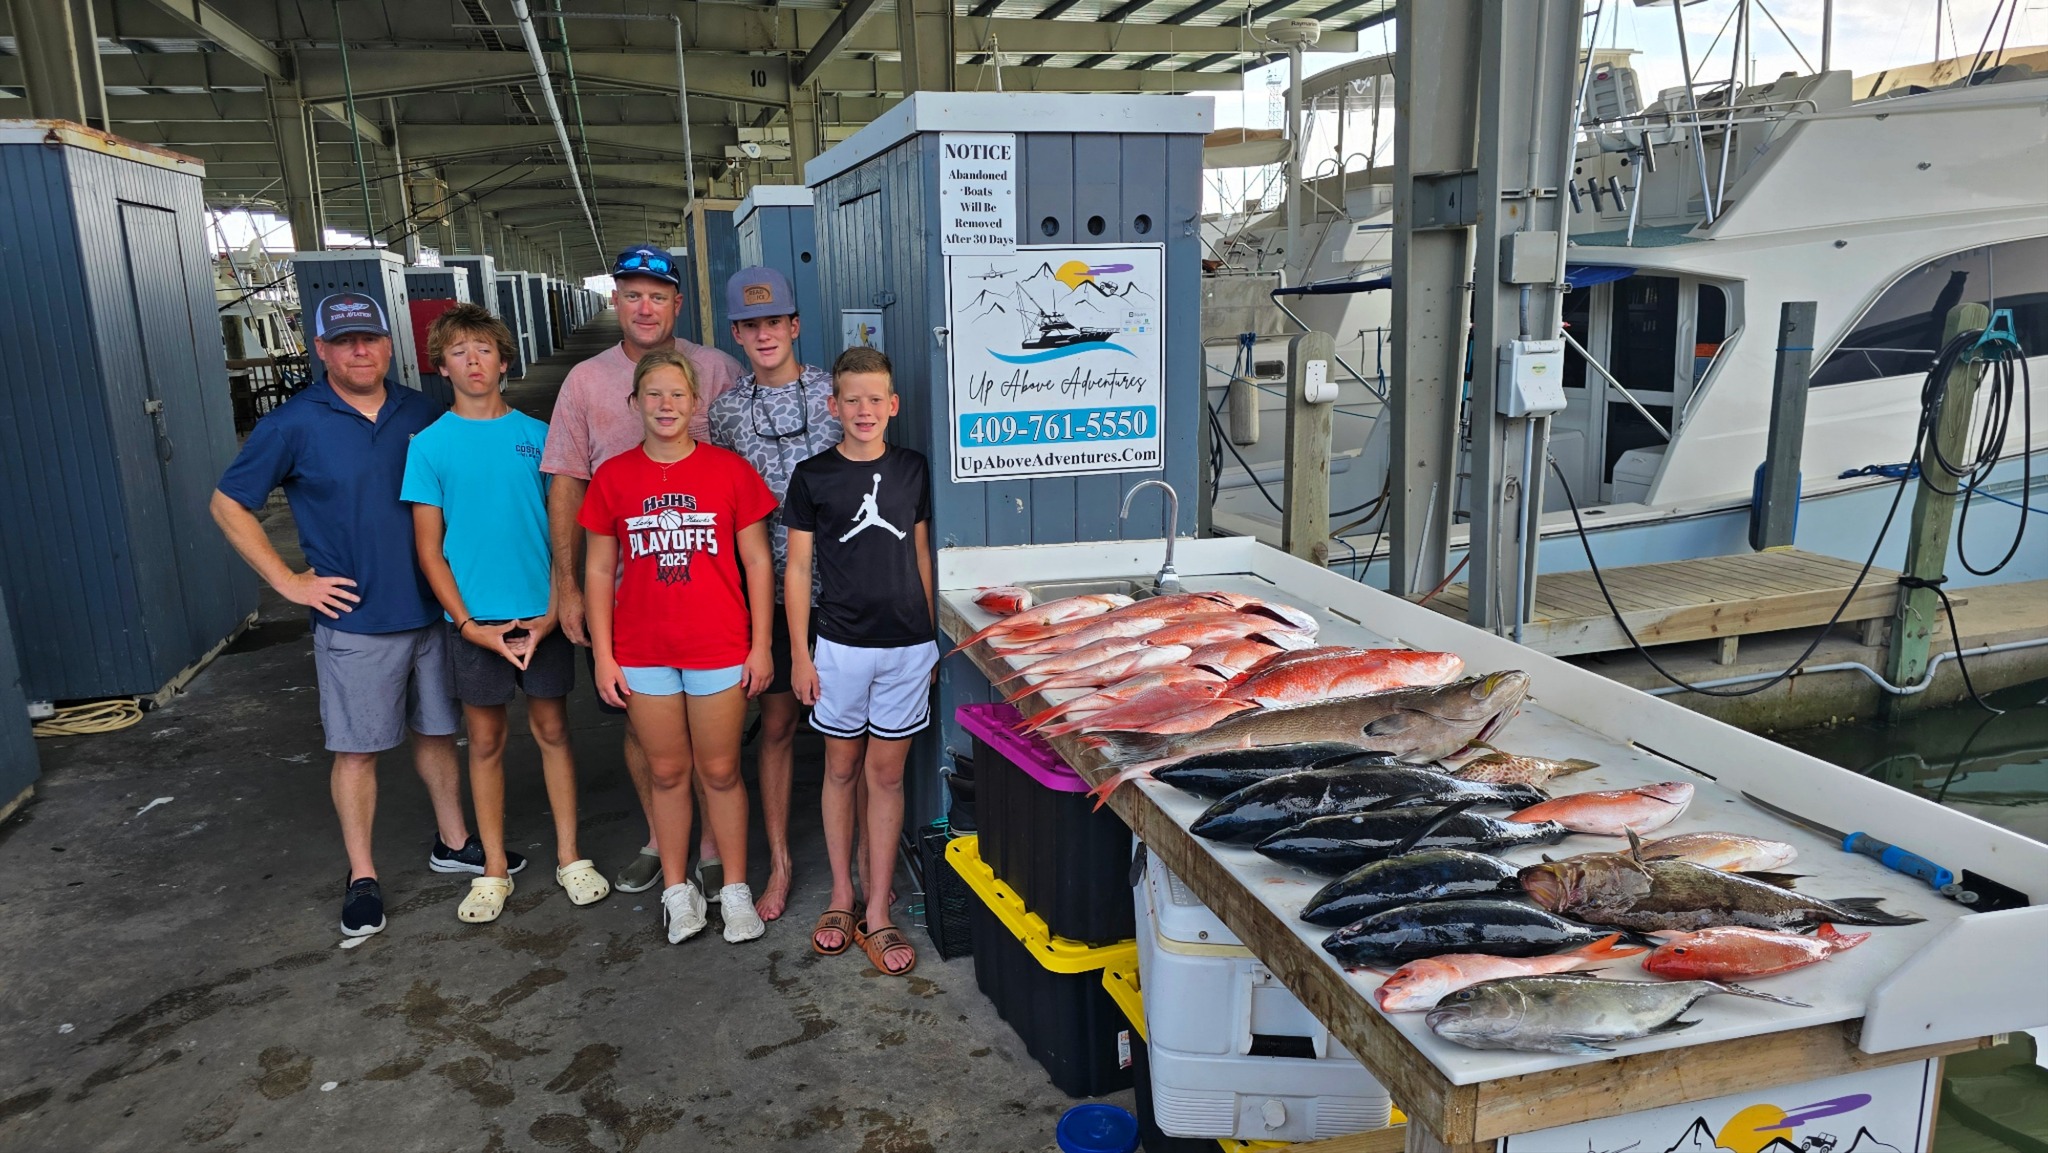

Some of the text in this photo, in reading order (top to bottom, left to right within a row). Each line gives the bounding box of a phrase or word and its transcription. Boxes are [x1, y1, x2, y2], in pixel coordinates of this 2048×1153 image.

[751, 70, 766, 87] 10
[945, 144, 1011, 160] NOTICE
[949, 169, 1007, 180] Abandoned
[964, 186, 992, 196] Boats
[961, 202, 997, 212] Will Be
[955, 218, 1002, 228] Removed
[945, 234, 1014, 246] After 30 Days
[969, 366, 1147, 406] Up Above Adventures
[969, 409, 1148, 444] 409-761-5550
[516, 445, 541, 455] COSTA
[960, 448, 1157, 473] UpAboveAdventures.Com
[643, 494, 696, 514] HJHS
[628, 528, 718, 560] PLAYOFFS
[659, 552, 688, 567] 2025
